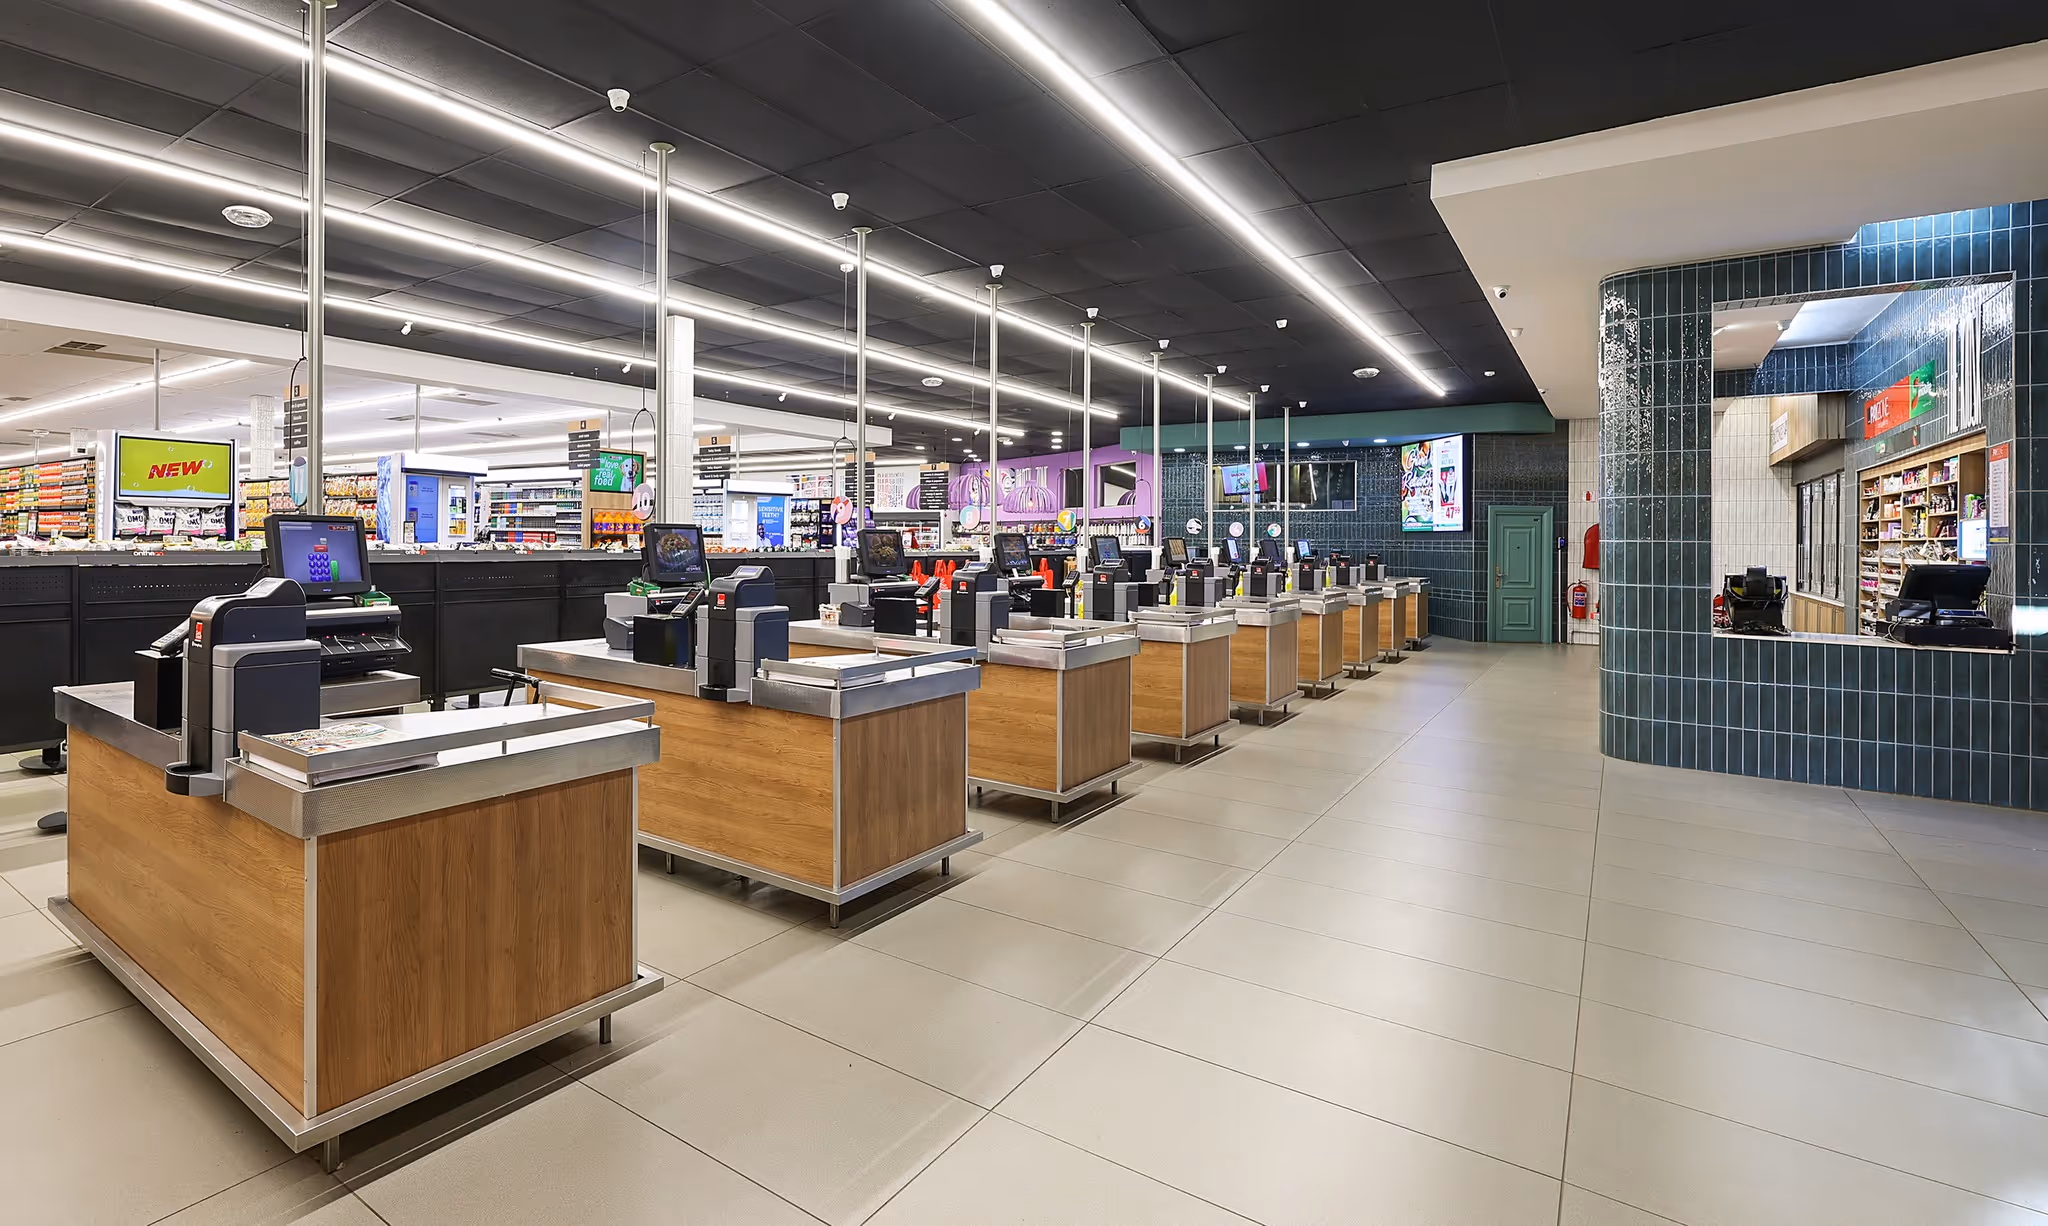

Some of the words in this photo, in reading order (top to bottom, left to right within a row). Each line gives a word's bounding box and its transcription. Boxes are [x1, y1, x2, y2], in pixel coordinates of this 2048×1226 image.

[148, 460, 205, 479] NEW
[604, 460, 619, 469] love
[598, 469, 614, 478] real
[594, 474, 616, 486] food
[635, 492, 650, 511] 10
[127, 515, 143, 523] OMO
[1062, 514, 1071, 526] 7
[1138, 520, 1145, 529] 6
